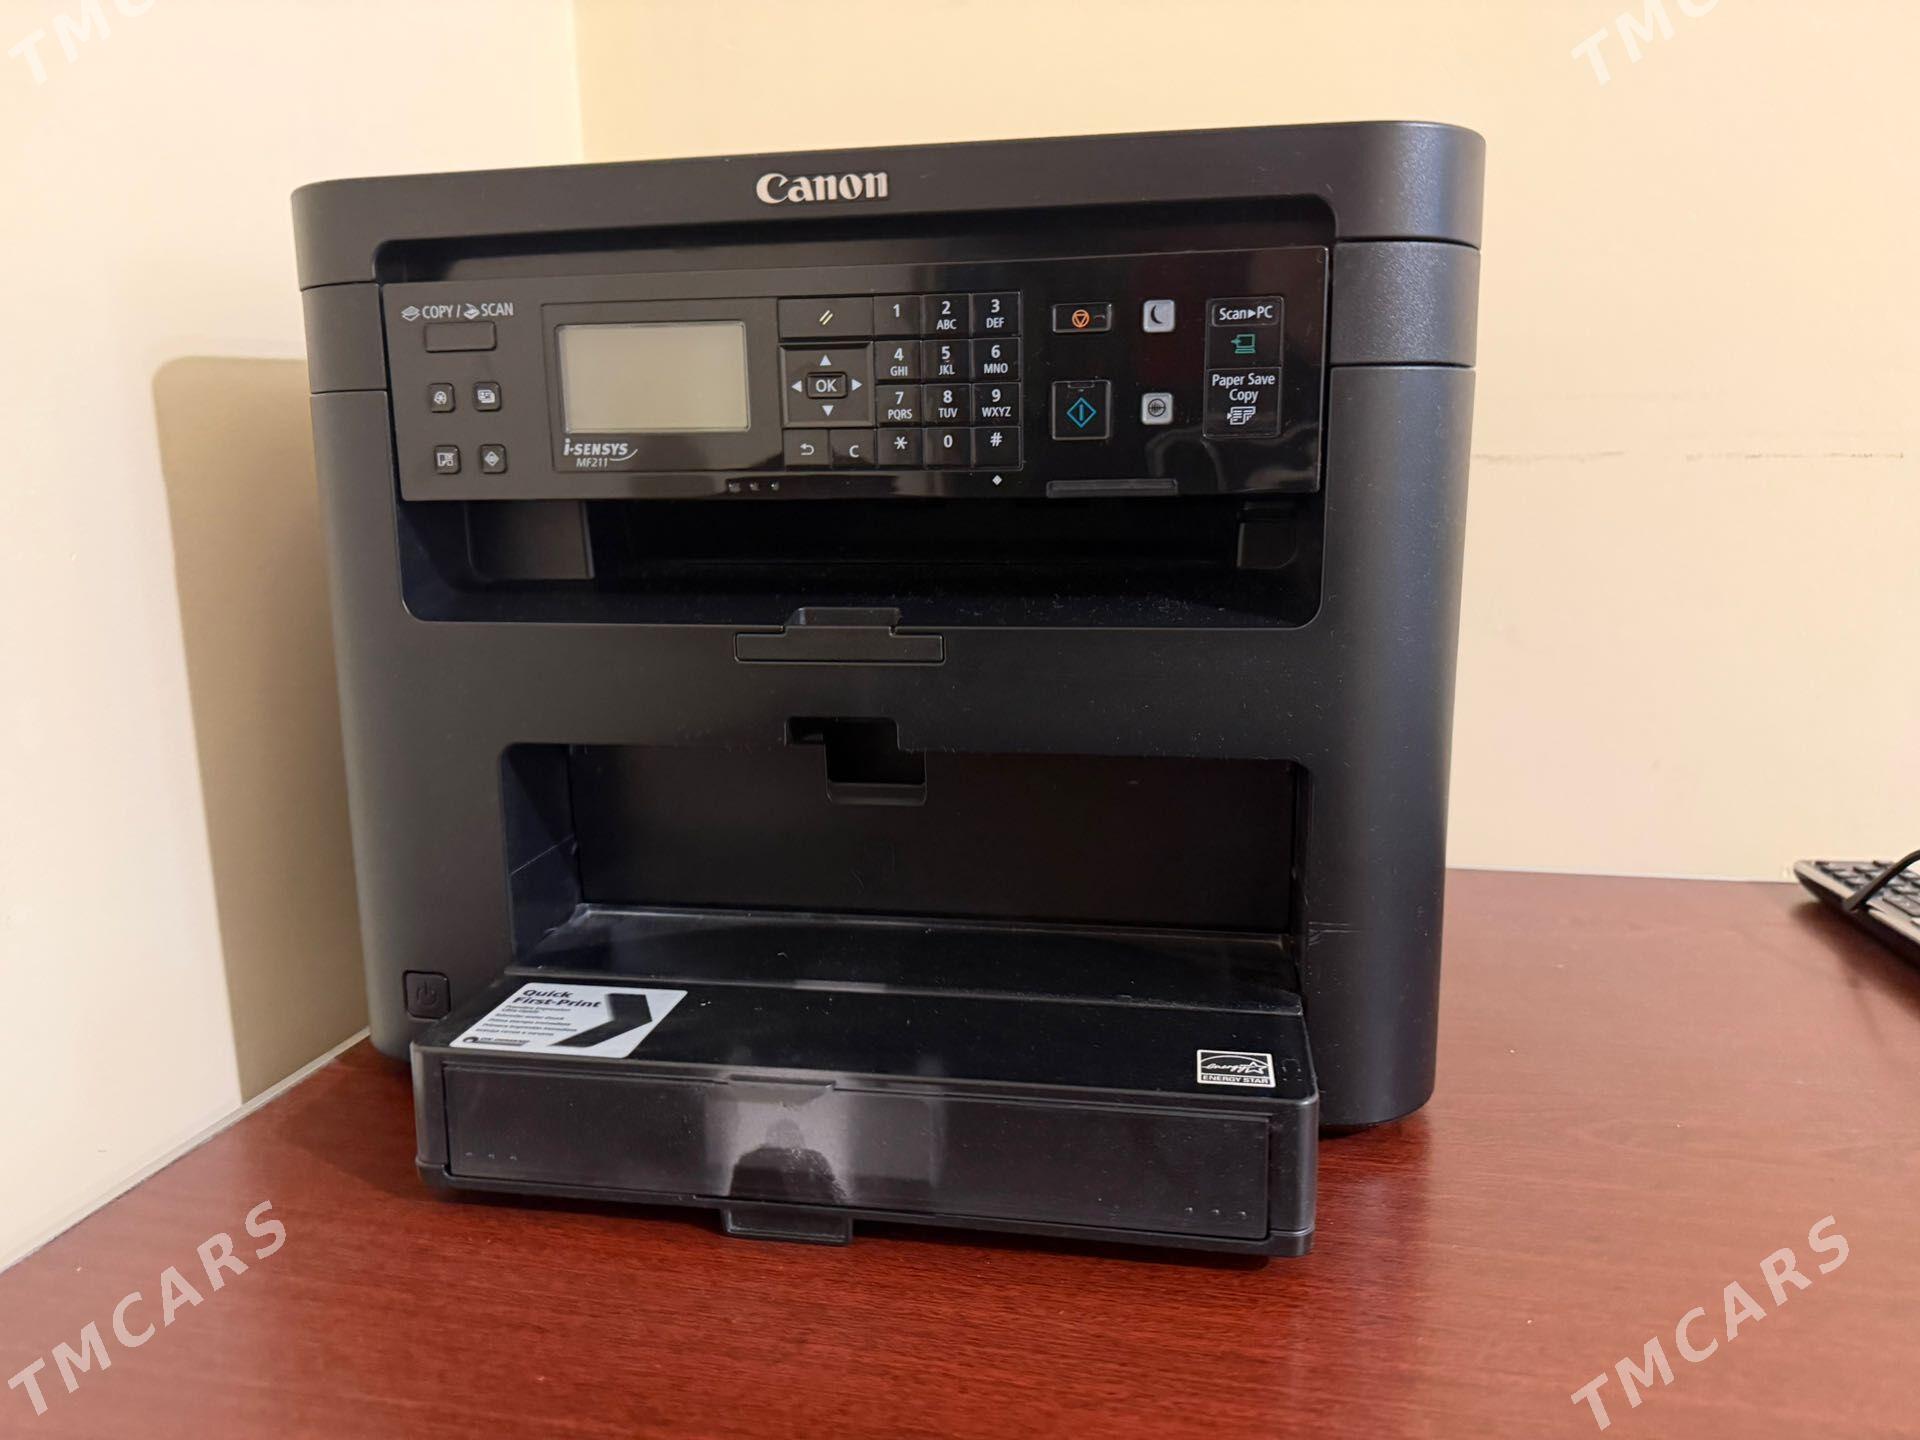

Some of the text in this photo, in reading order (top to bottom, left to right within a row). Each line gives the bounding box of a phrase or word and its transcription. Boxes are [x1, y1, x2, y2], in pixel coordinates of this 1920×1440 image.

[756, 172, 888, 204] Canon
[422, 305, 453, 319] COPY
[481, 302, 514, 317] SCAN
[892, 304, 900, 317] 1
[941, 301, 951, 314] 2
[990, 299, 1000, 313] 3
[1219, 305, 1273, 321] Scan PC
[936, 319, 957, 330] ABC
[986, 317, 1005, 329] DEF
[893, 348, 903, 361] 4
[941, 346, 951, 359] 5
[991, 345, 1001, 358] 6
[890, 366, 908, 377] GHI
[938, 364, 955, 375] JKL
[983, 363, 1008, 374] MNO
[815, 379, 837, 393] OK
[1212, 373, 1275, 388] Paper Save
[894, 392, 904, 405] 7
[943, 390, 953, 403] 8
[991, 389, 1001, 402] 9
[1229, 389, 1258, 404] Copy
[887, 409, 912, 420] PQRS
[938, 408, 958, 418] TUV
[981, 407, 1011, 418] WXYZ
[943, 435, 953, 448] 0
[849, 445, 859, 458] C
[576, 457, 608, 468] MF211
[522, 989, 574, 999] Quick
[513, 996, 601, 1008] First-Print
[1202, 1074, 1241, 1083] ENERGY
